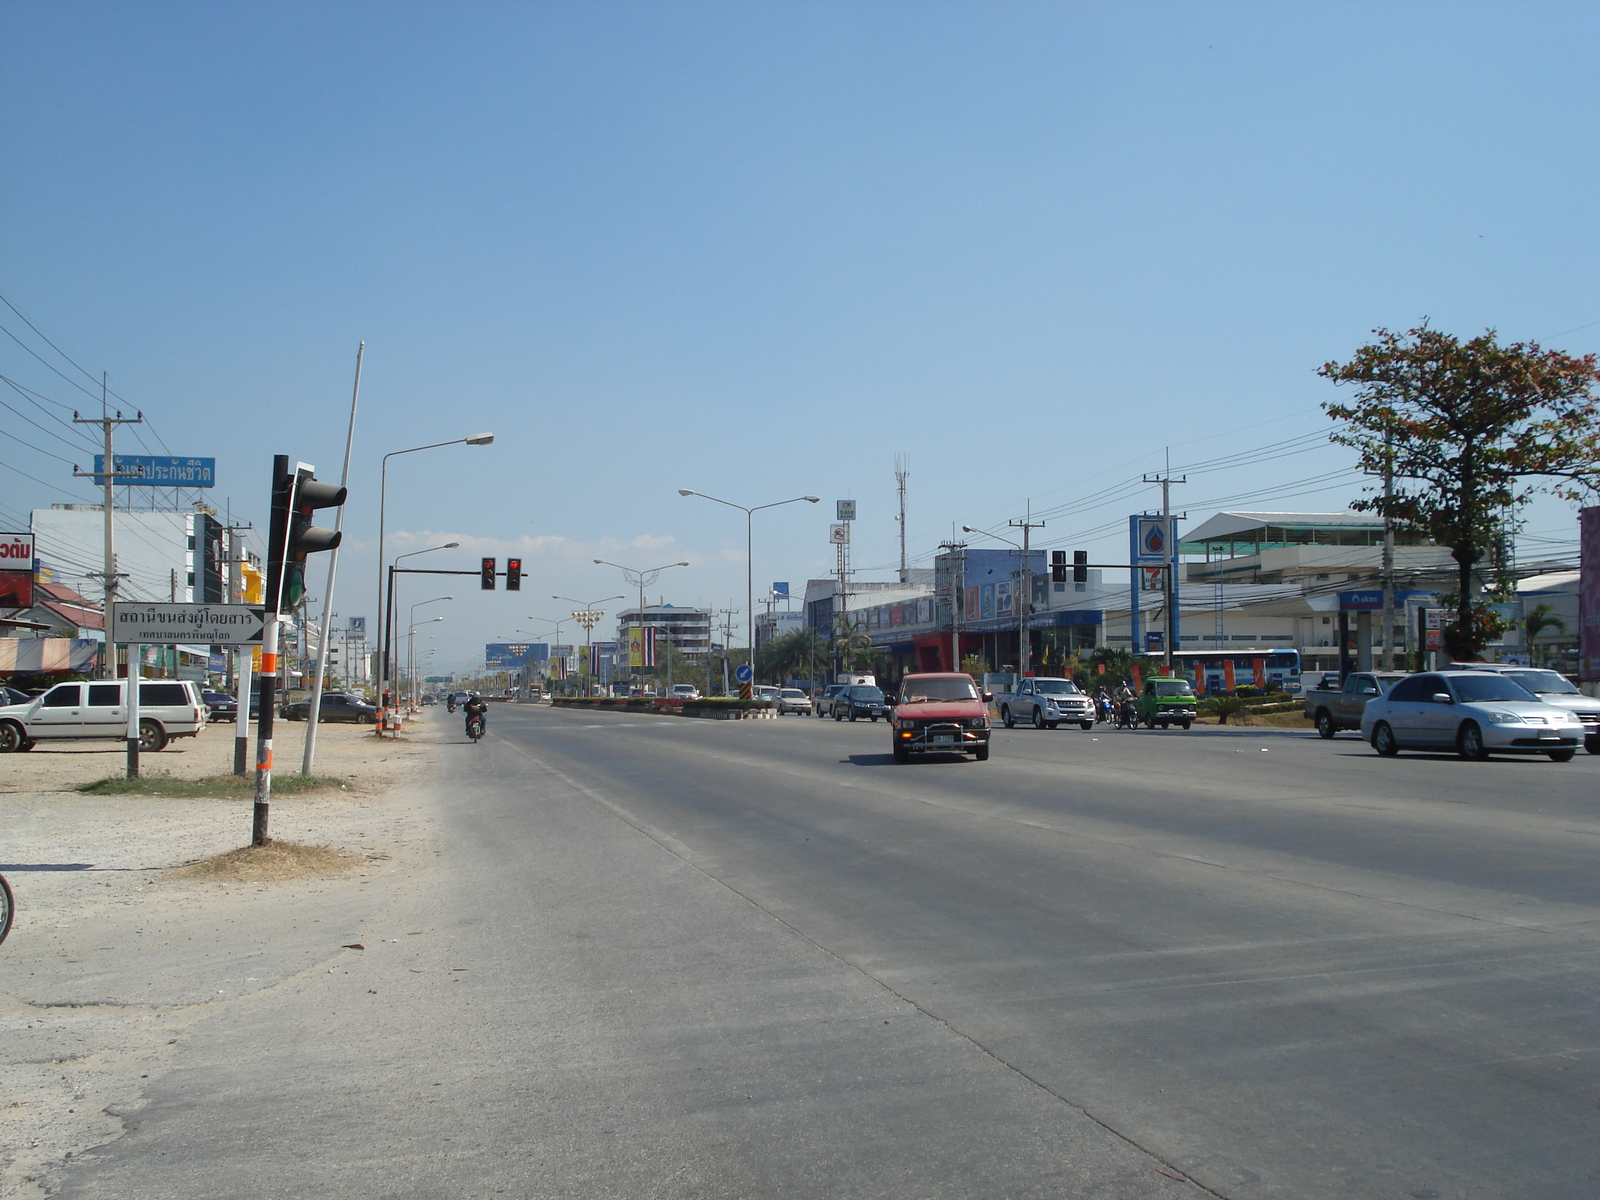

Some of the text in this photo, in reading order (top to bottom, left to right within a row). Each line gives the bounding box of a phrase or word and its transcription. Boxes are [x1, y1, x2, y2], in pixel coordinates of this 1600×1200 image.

[120, 608, 252, 628] สถานีขนส่งผู้โดยสาร
[140, 629, 230, 642] เทศบาลนครพิษณุโลก
